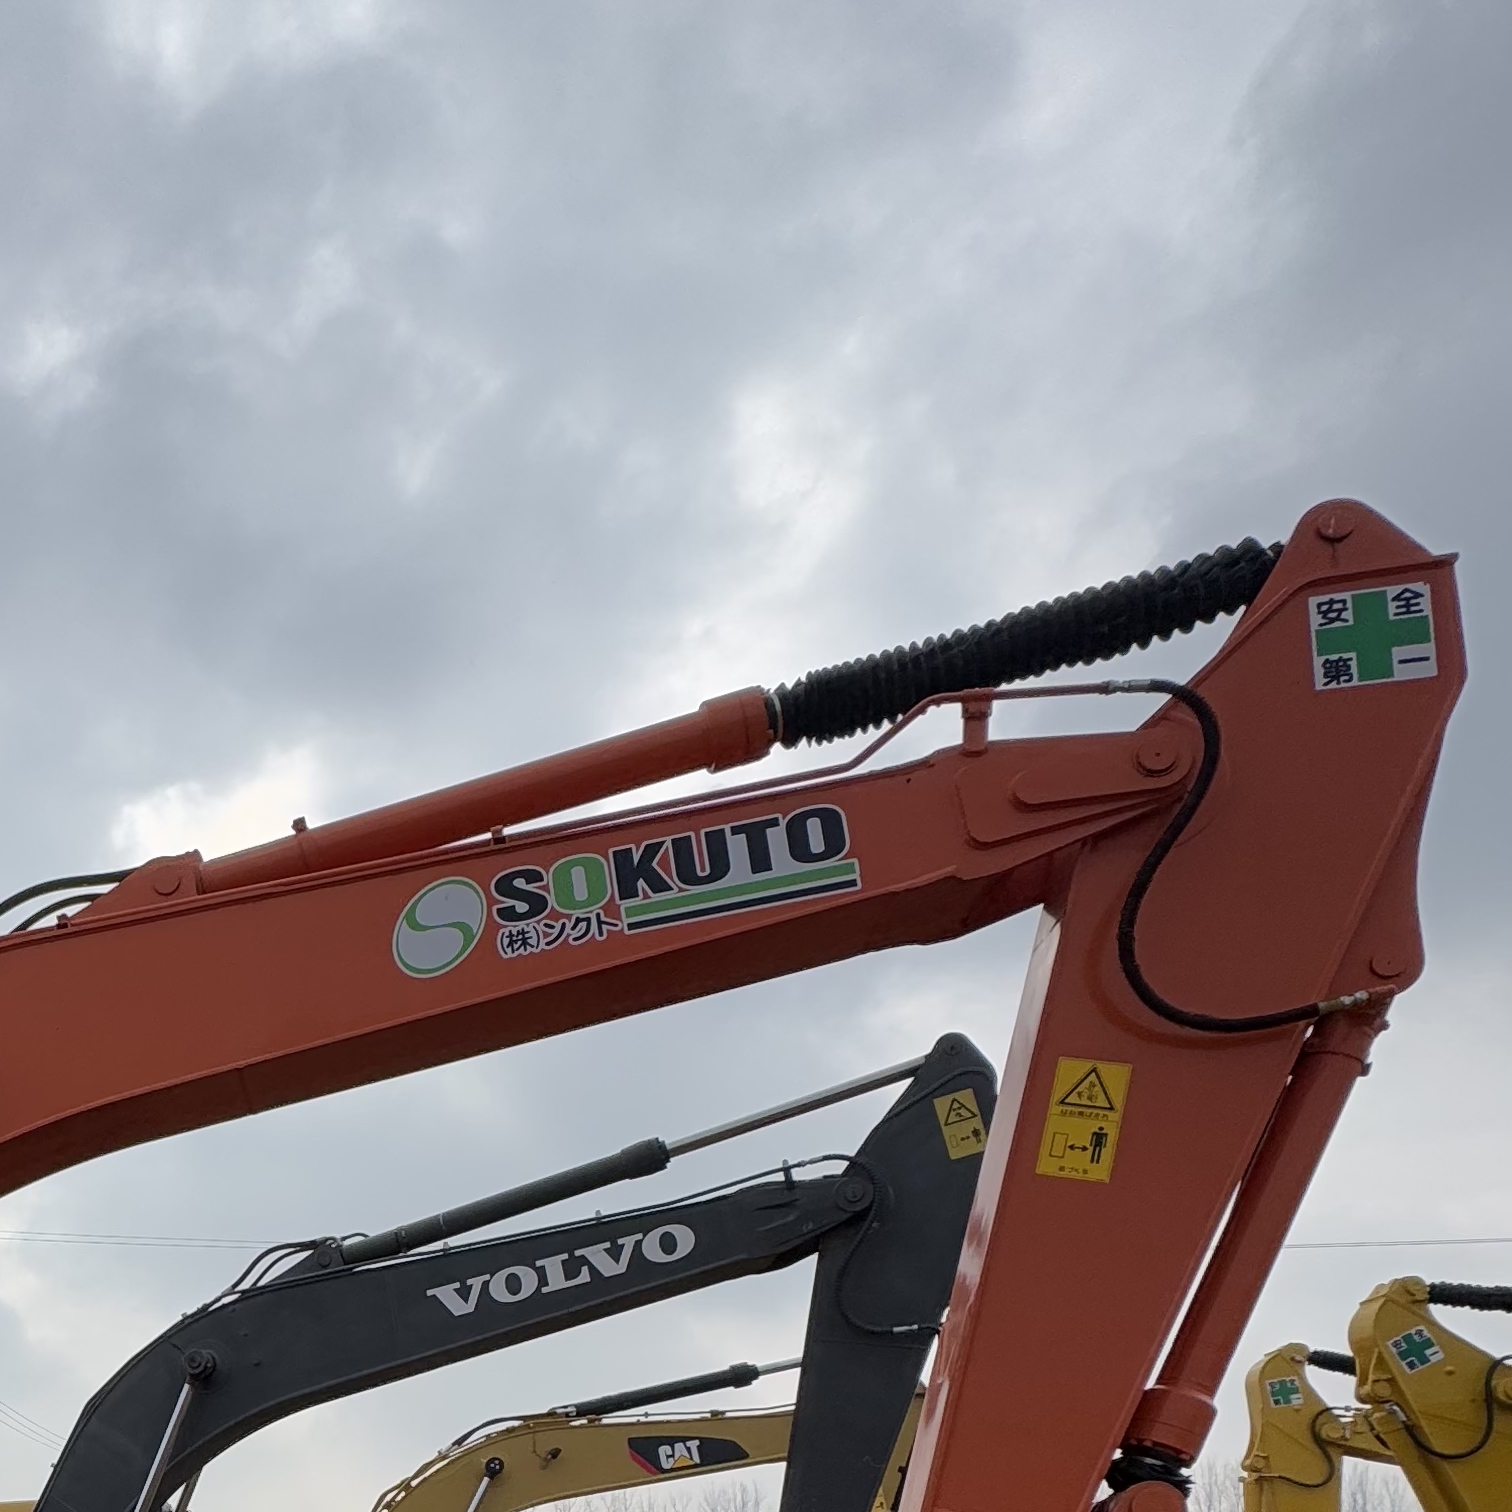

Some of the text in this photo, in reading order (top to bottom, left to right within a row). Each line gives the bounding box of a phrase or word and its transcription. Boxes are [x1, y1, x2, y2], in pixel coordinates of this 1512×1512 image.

[1316, 587, 1425, 627] 安 全
[1321, 656, 1354, 687] 第
[494, 806, 847, 924] SOKUTO
[426, 1224, 696, 1317] VOLVO
[657, 1439, 701, 1470] CAT
